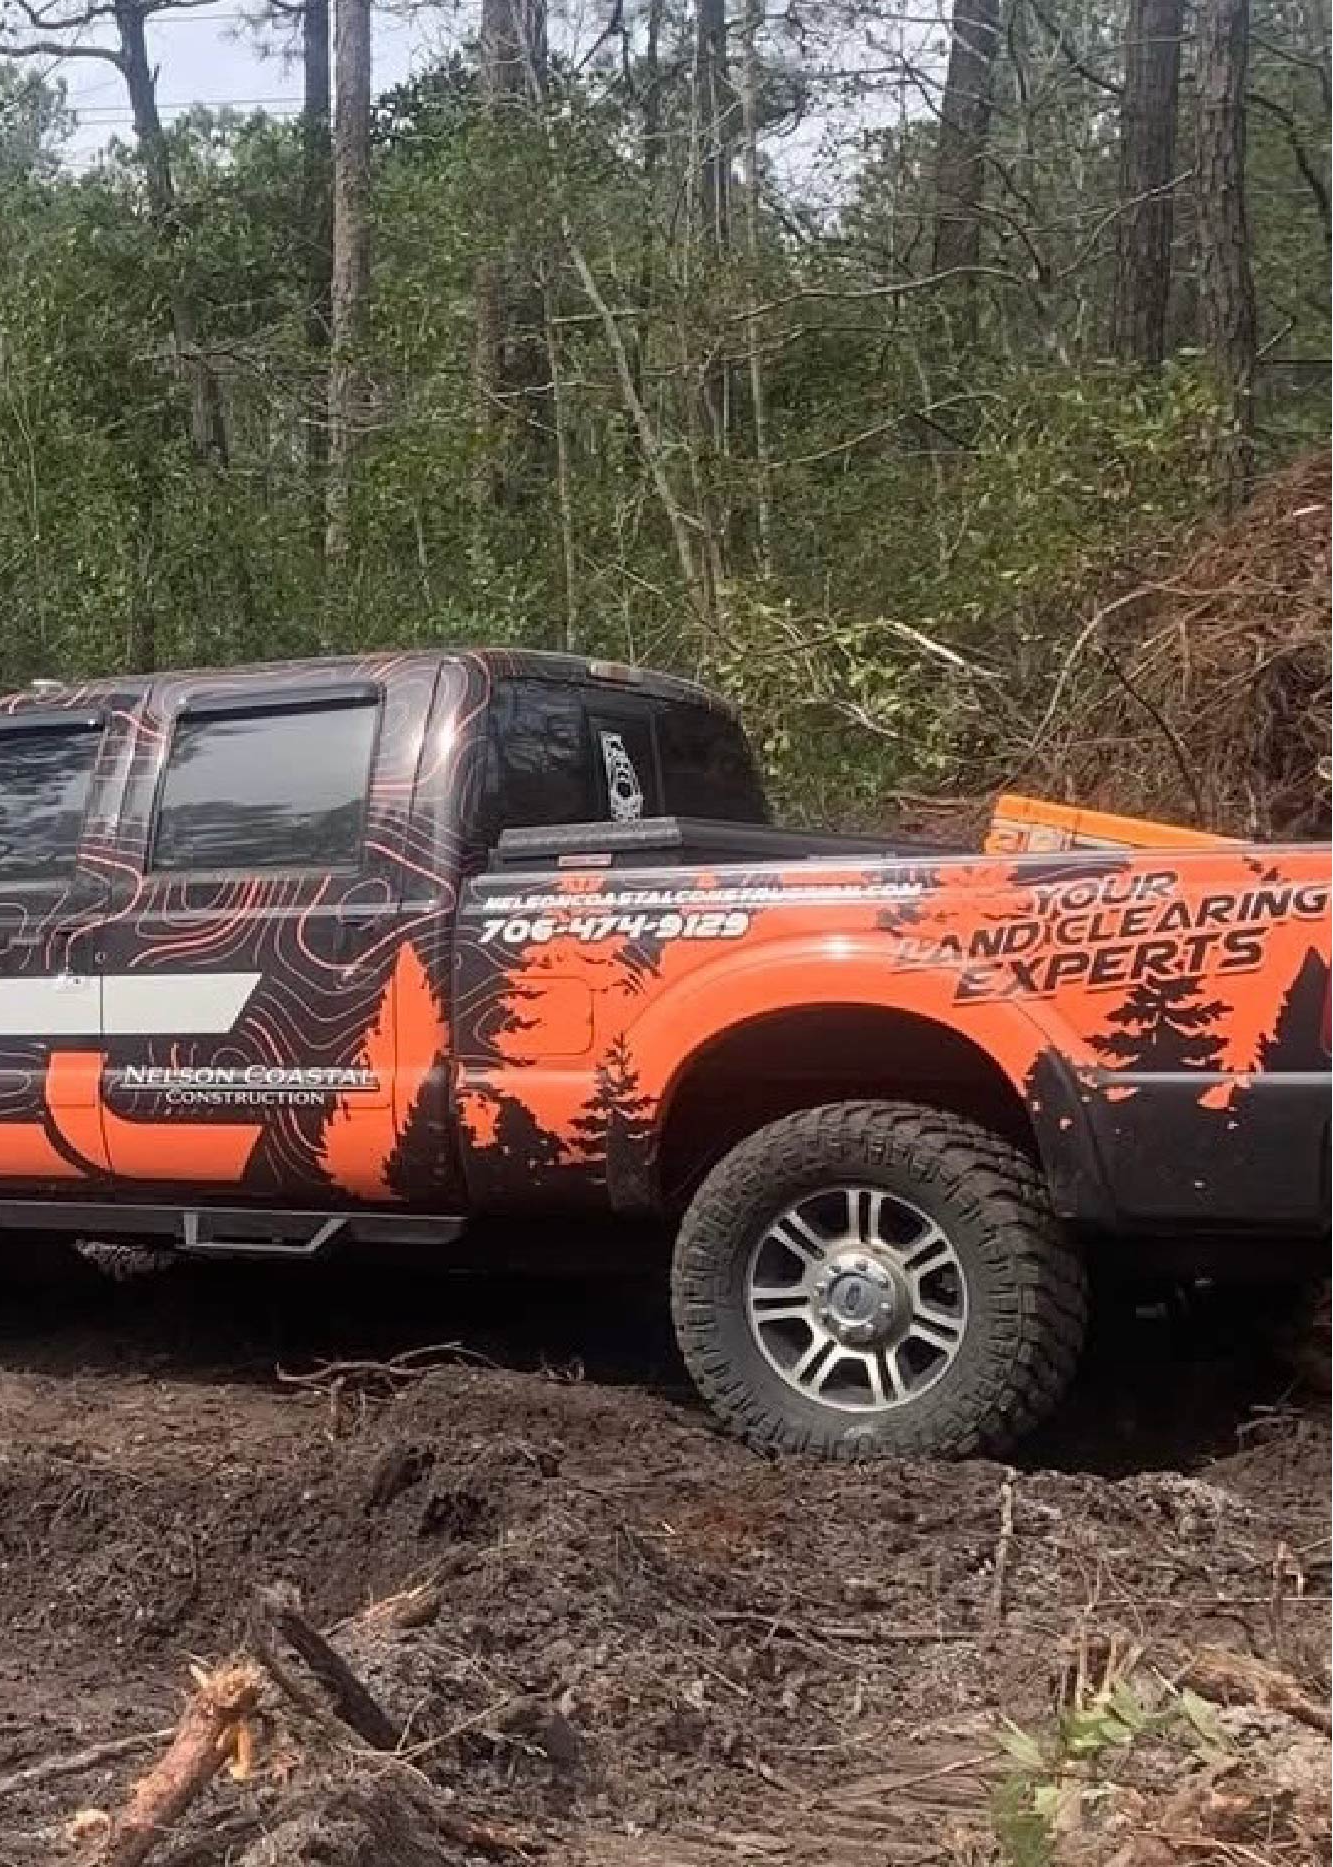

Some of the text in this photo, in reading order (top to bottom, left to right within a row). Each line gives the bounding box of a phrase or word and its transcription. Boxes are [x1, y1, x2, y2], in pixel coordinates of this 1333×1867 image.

[1032, 871, 1179, 915] YOUR
[479, 911, 749, 943] 706-474-9129
[896, 885, 1330, 967] LAND CLEARING
[955, 926, 1270, 1002] EXPERTS
[125, 1065, 380, 1085] NELSON COASTAL
[165, 1090, 326, 1105] CONSTRUCTION
